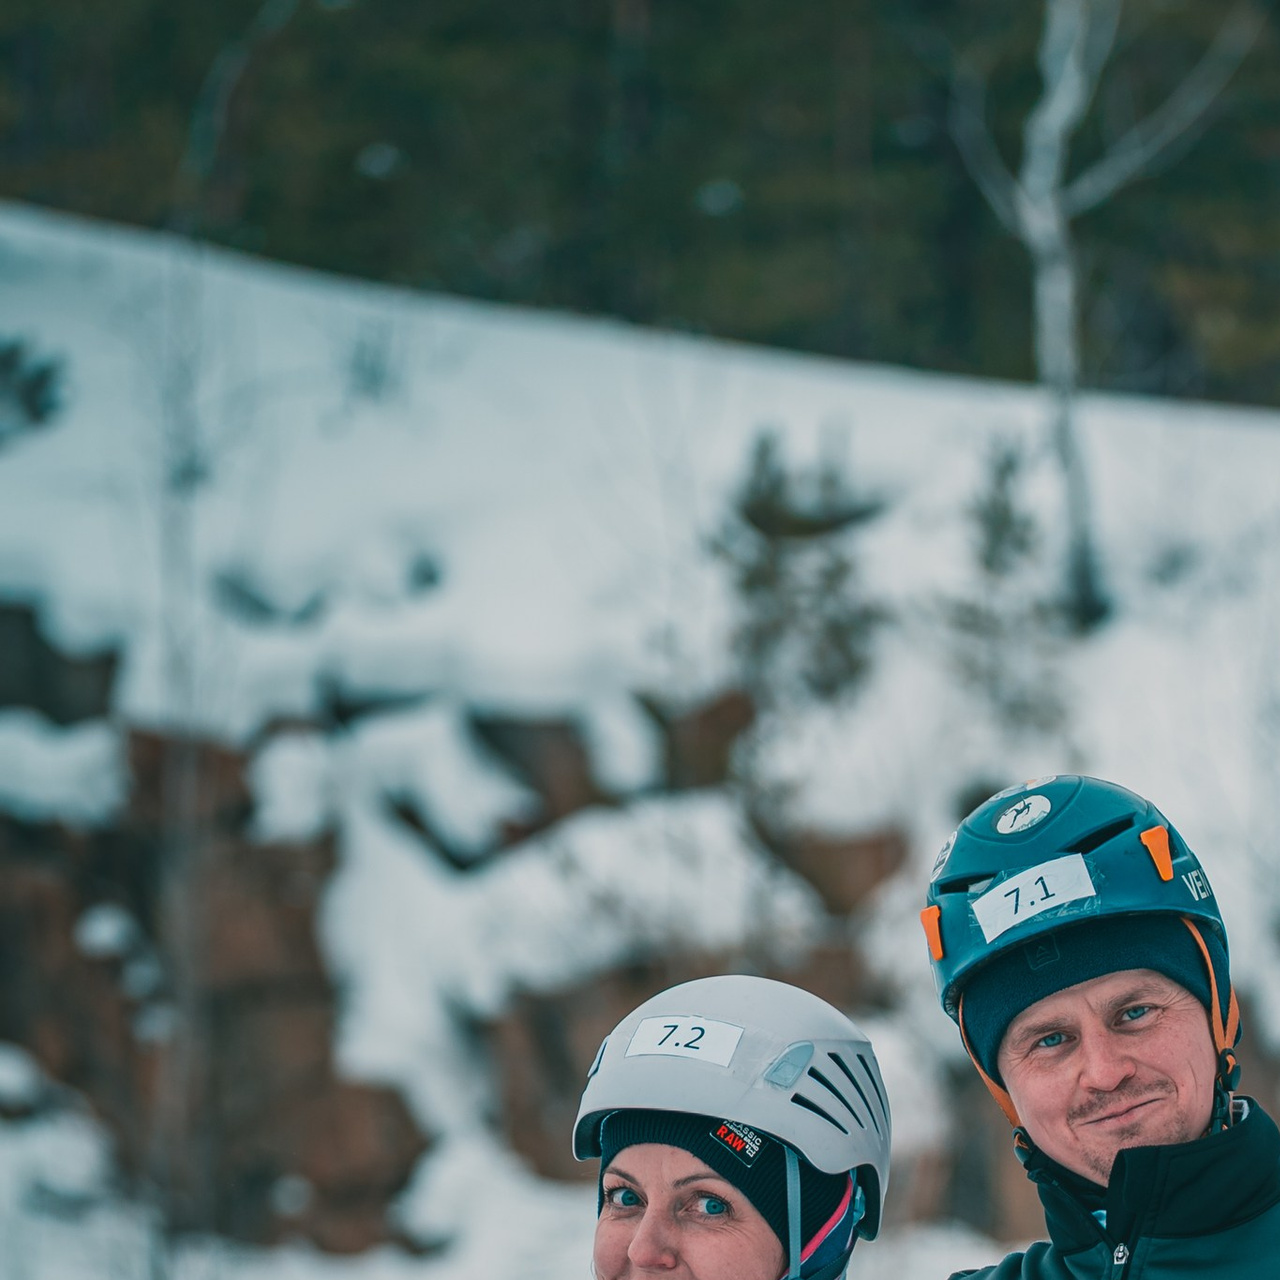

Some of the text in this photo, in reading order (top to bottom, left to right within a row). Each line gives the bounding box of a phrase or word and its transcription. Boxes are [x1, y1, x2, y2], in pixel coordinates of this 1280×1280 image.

[1003, 875, 1056, 915] 7.1
[657, 1024, 706, 1050] 7.2
[716, 1124, 746, 1152] RAW
[729, 1120, 762, 1146] LASSIC
